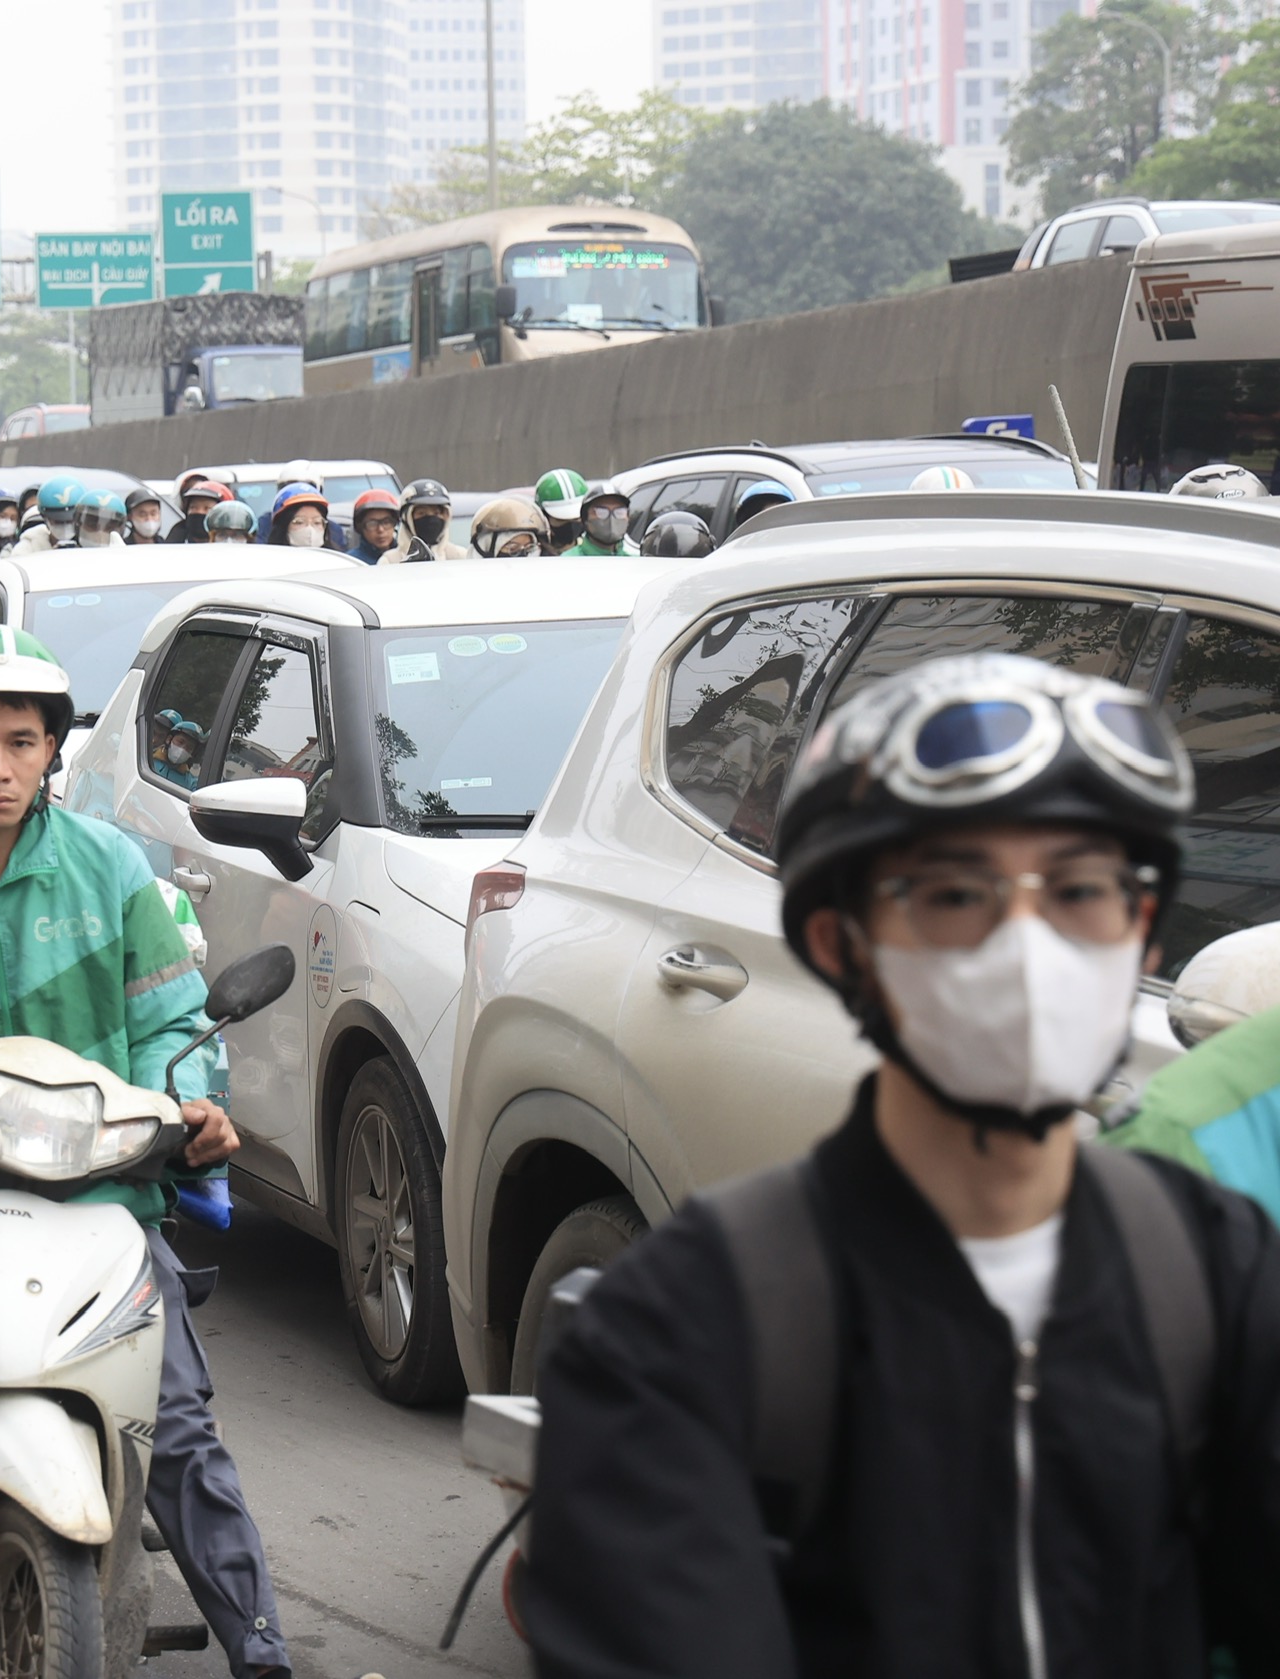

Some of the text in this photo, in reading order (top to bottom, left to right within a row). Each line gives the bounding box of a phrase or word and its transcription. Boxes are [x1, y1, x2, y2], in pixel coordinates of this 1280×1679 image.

[175, 197, 239, 226] LỐI RA
[72, 241, 98, 257] BAY
[191, 233, 224, 250] EXIT
[34, 909, 102, 942] Grab
